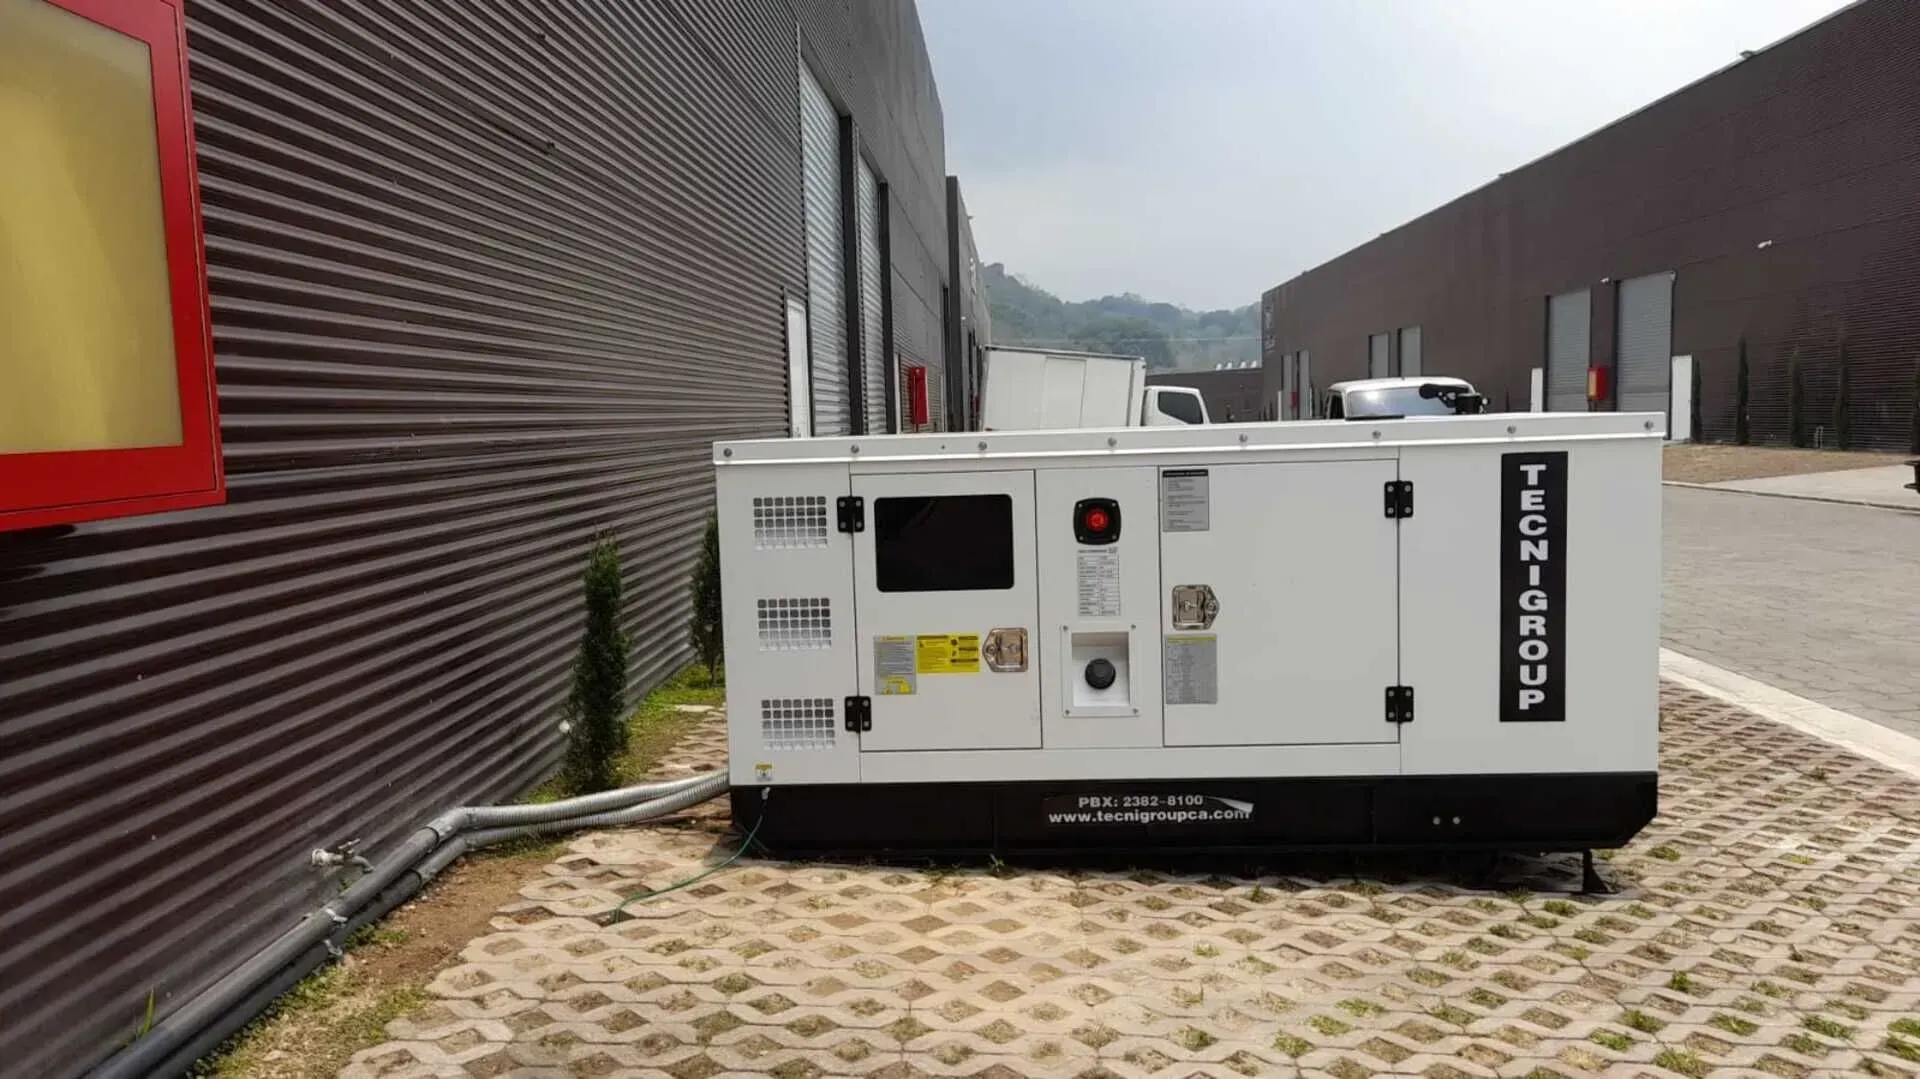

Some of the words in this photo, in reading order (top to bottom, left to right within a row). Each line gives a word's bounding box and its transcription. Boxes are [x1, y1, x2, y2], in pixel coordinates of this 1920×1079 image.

[1518, 463, 1549, 711] TECNIGROUP
[1078, 796, 1118, 808] PBX:
[1123, 795, 1204, 807] 2382-8100
[1048, 808, 1250, 823] www.tecnigroupca.com
